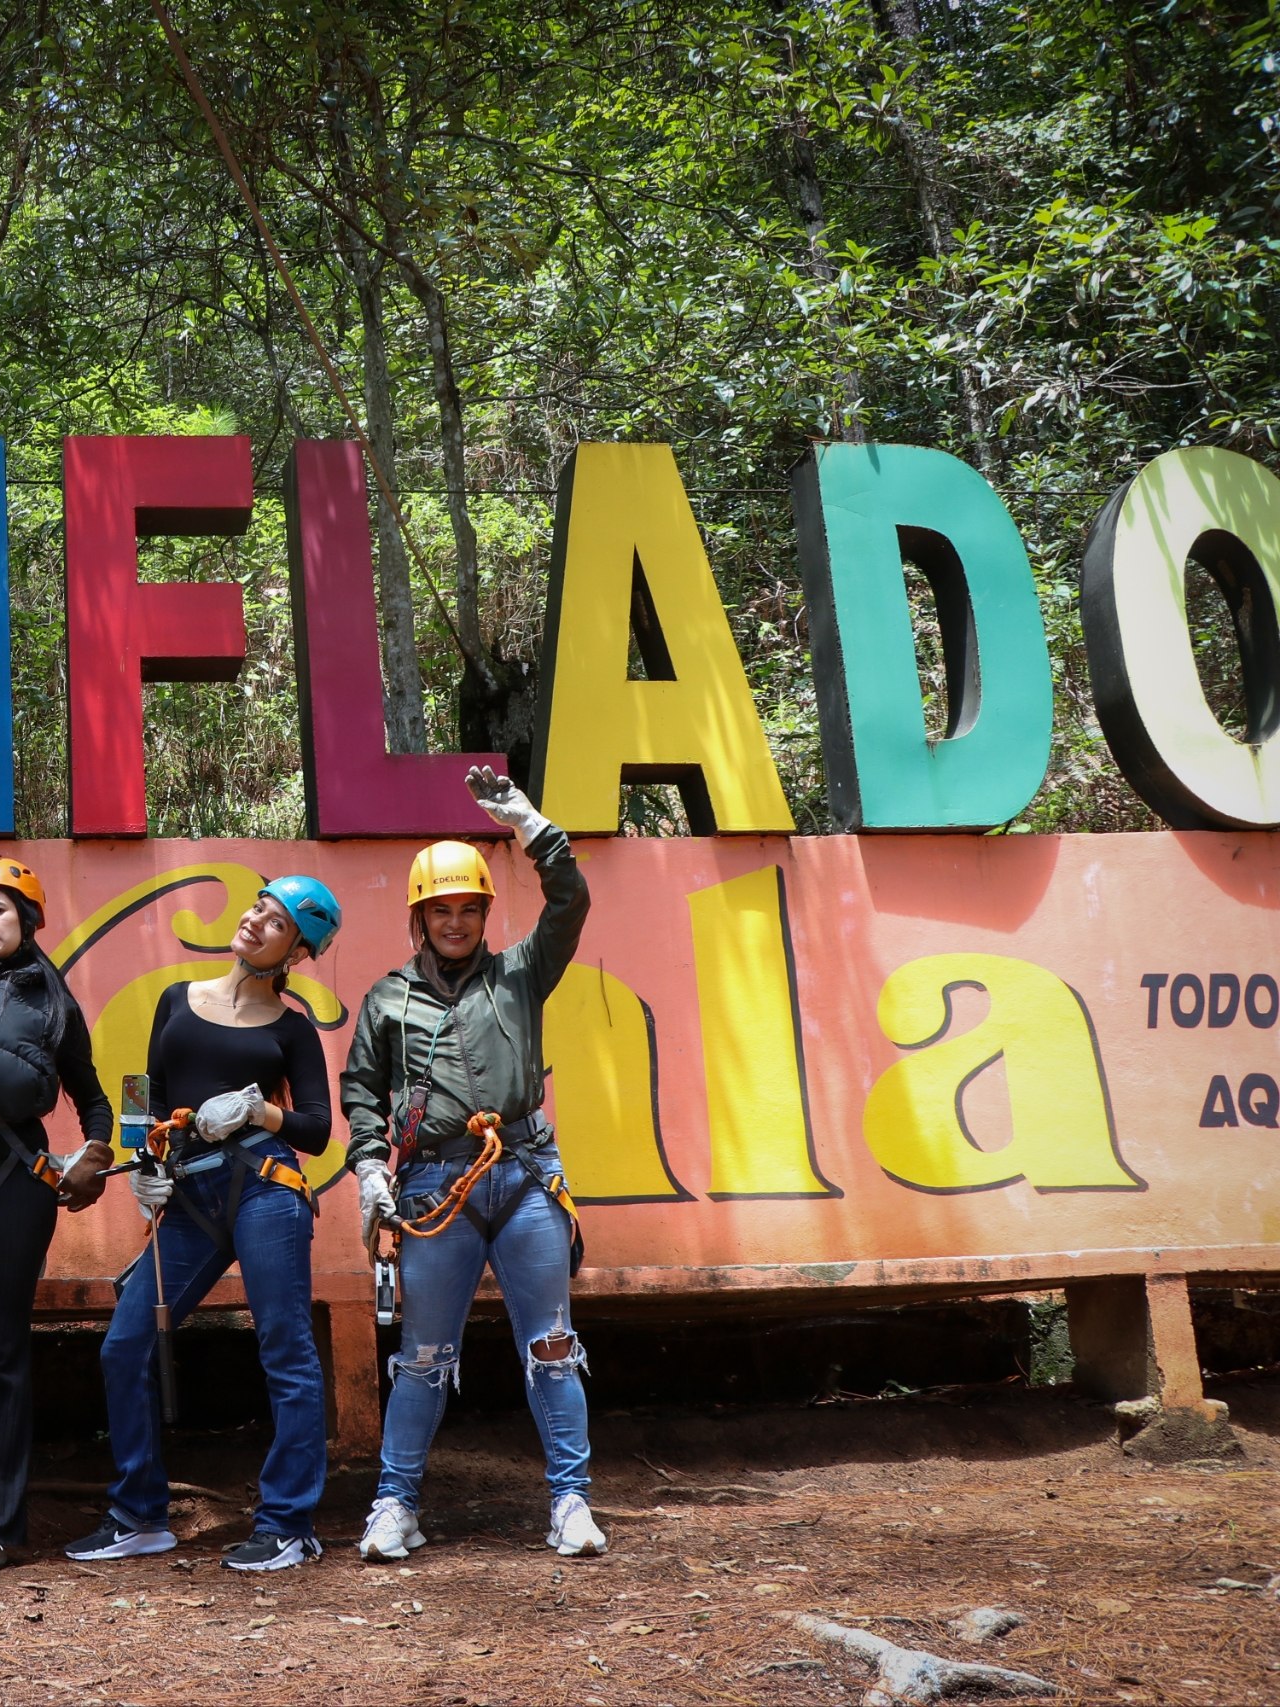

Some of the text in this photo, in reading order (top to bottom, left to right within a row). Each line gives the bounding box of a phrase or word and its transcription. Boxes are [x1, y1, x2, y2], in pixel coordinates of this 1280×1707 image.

[433, 875, 470, 884] EDELRID
[1140, 973, 1280, 1029] TODO
[1198, 1072, 1280, 1129] AQ
